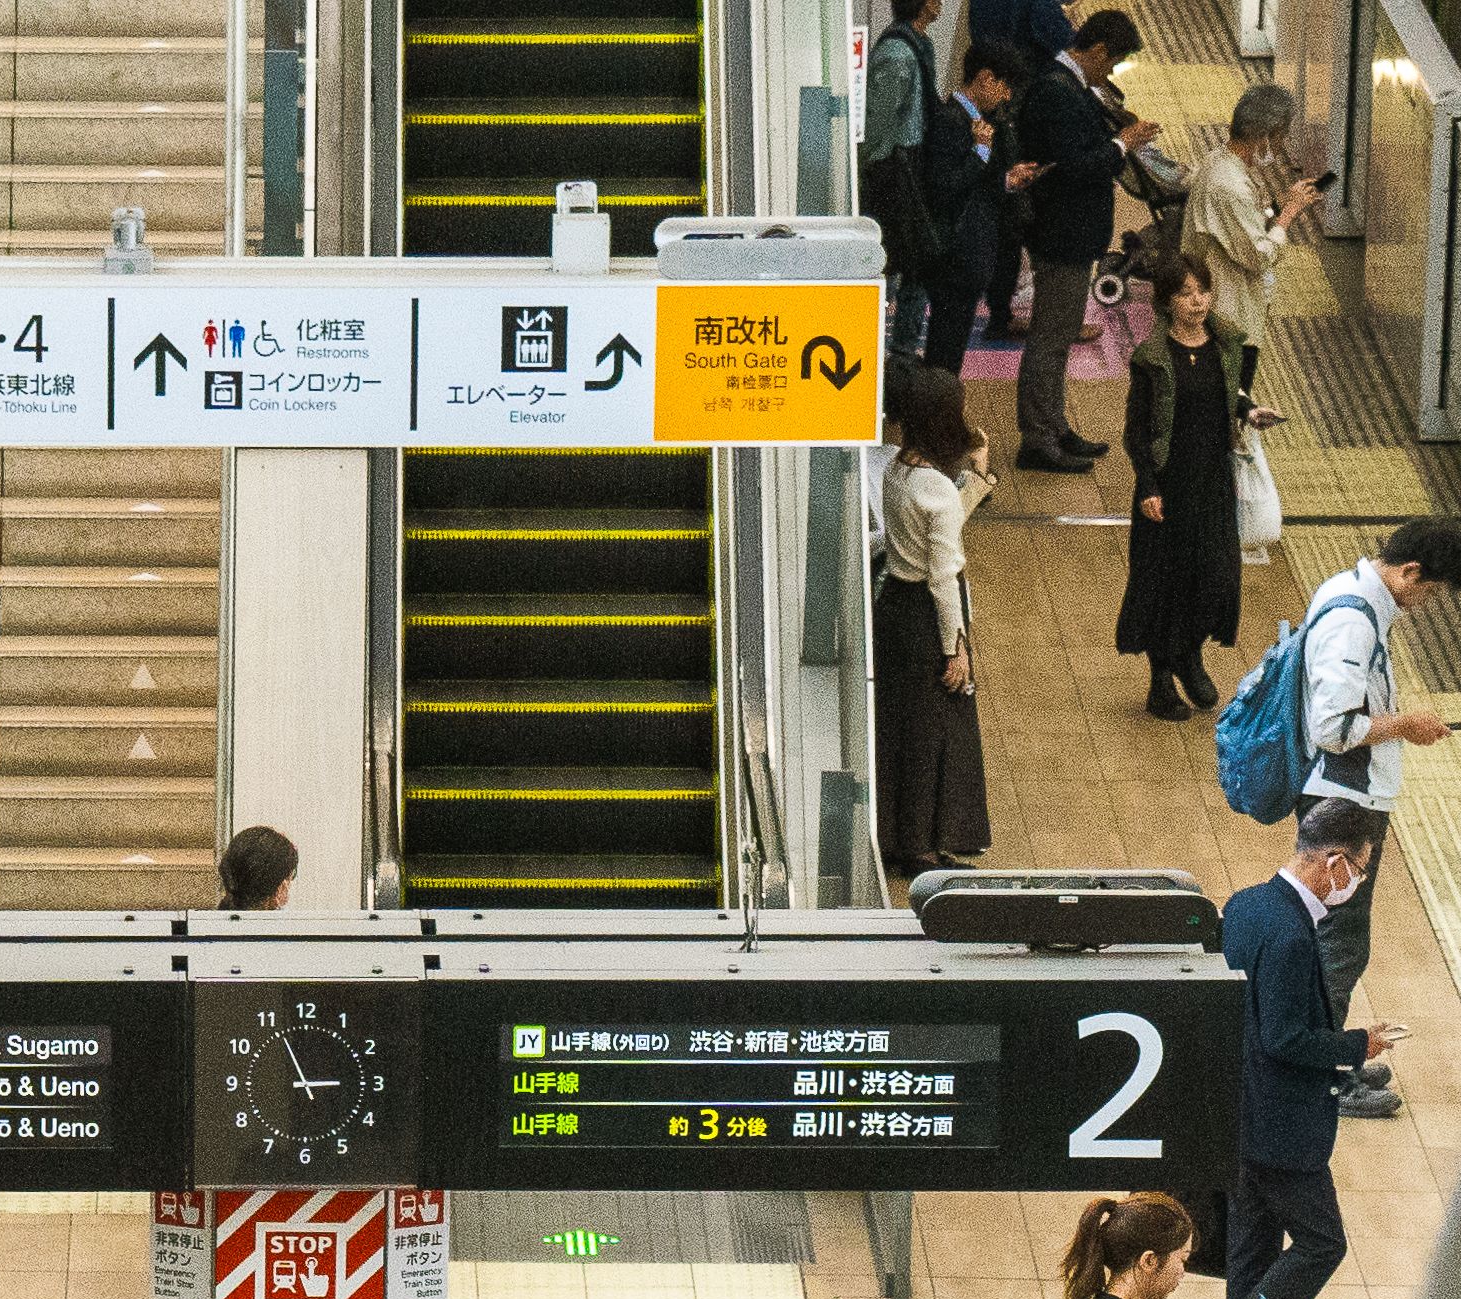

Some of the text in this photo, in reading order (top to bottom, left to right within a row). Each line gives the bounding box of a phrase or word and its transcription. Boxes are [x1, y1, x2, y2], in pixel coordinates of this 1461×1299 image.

[297, 318, 365, 342] 化粧室
[694, 315, 788, 346] 南改札
[296, 346, 370, 360] Restrooms
[684, 352, 788, 369] South Gate
[249, 372, 382, 393] コインロッカー
[447, 384, 567, 405] エレベーター
[51, 401, 77, 414] Line
[249, 398, 337, 412] Coin Lockers
[509, 410, 566, 424] Elevator
[296, 1003, 317, 1019] 12
[257, 1012, 276, 1027] 11
[338, 1013, 347, 1028] 1
[6, 1035, 99, 1060] Sugamo
[229, 1038, 251, 1054] 10
[365, 1039, 376, 1055] 2
[518, 1033, 539, 1049] JY
[689, 1030, 890, 1053] 渋谷・新宿・池袋方面
[17, 1076, 34, 1096] &
[40, 1076, 100, 1096] Ueno
[226, 1076, 238, 1091] 9
[373, 1076, 384, 1092] 3
[513, 1069, 955, 1096] 山手線 品川・渋谷方面
[1067, 1012, 1163, 1158] 2
[235, 1112, 248, 1128] 8
[362, 1111, 374, 1126] 4
[513, 1108, 954, 1140] 山手線 約 3 分後 品川・渋谷方面
[17, 1118, 34, 1138] &
[40, 1118, 100, 1138] Ueno
[263, 1138, 274, 1154] 7
[337, 1139, 348, 1154] 5
[299, 1148, 311, 1164] 6
[155, 1230, 204, 1250] 非常停止
[270, 1235, 333, 1254] STOP
[394, 1231, 443, 1250] 非常停止
[155, 1249, 192, 1266] ボタン
[406, 1251, 442, 1266] ボタン
[403, 1278, 443, 1289] Train Stop
